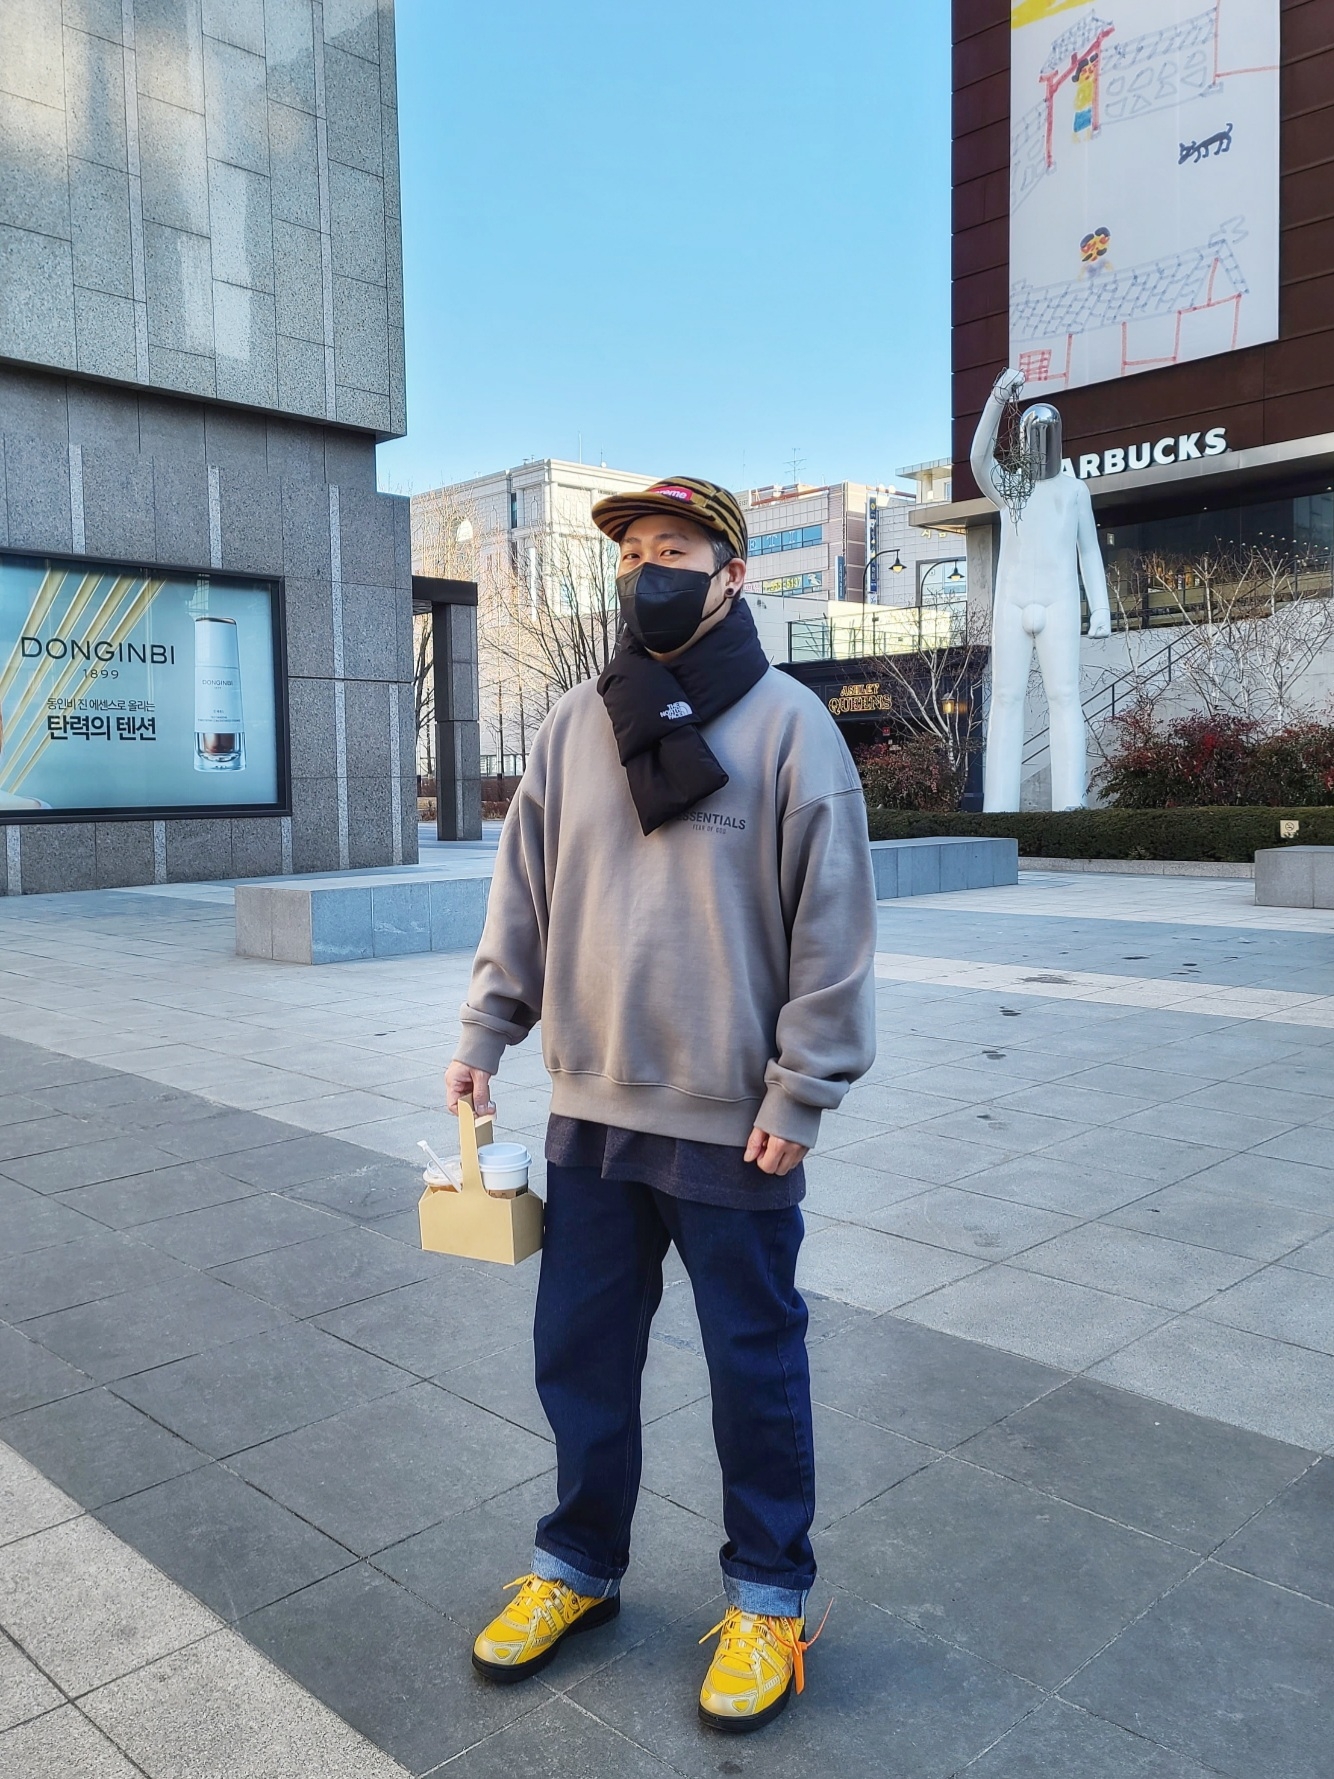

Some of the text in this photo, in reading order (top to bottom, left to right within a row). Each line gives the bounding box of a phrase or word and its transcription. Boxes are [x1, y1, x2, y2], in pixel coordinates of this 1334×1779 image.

[1061, 427, 1226, 479] ARBUCKS
[21, 636, 175, 665] DONGINBI
[83, 668, 119, 679] 1899
[840, 683, 880, 697] ASHLEY
[47, 698, 156, 712] 동인비 진 에센스로 올리는
[828, 695, 893, 715] QUEENS
[47, 715, 157, 741] 탄력의 텐션
[682, 811, 746, 830] SSENTIALS
